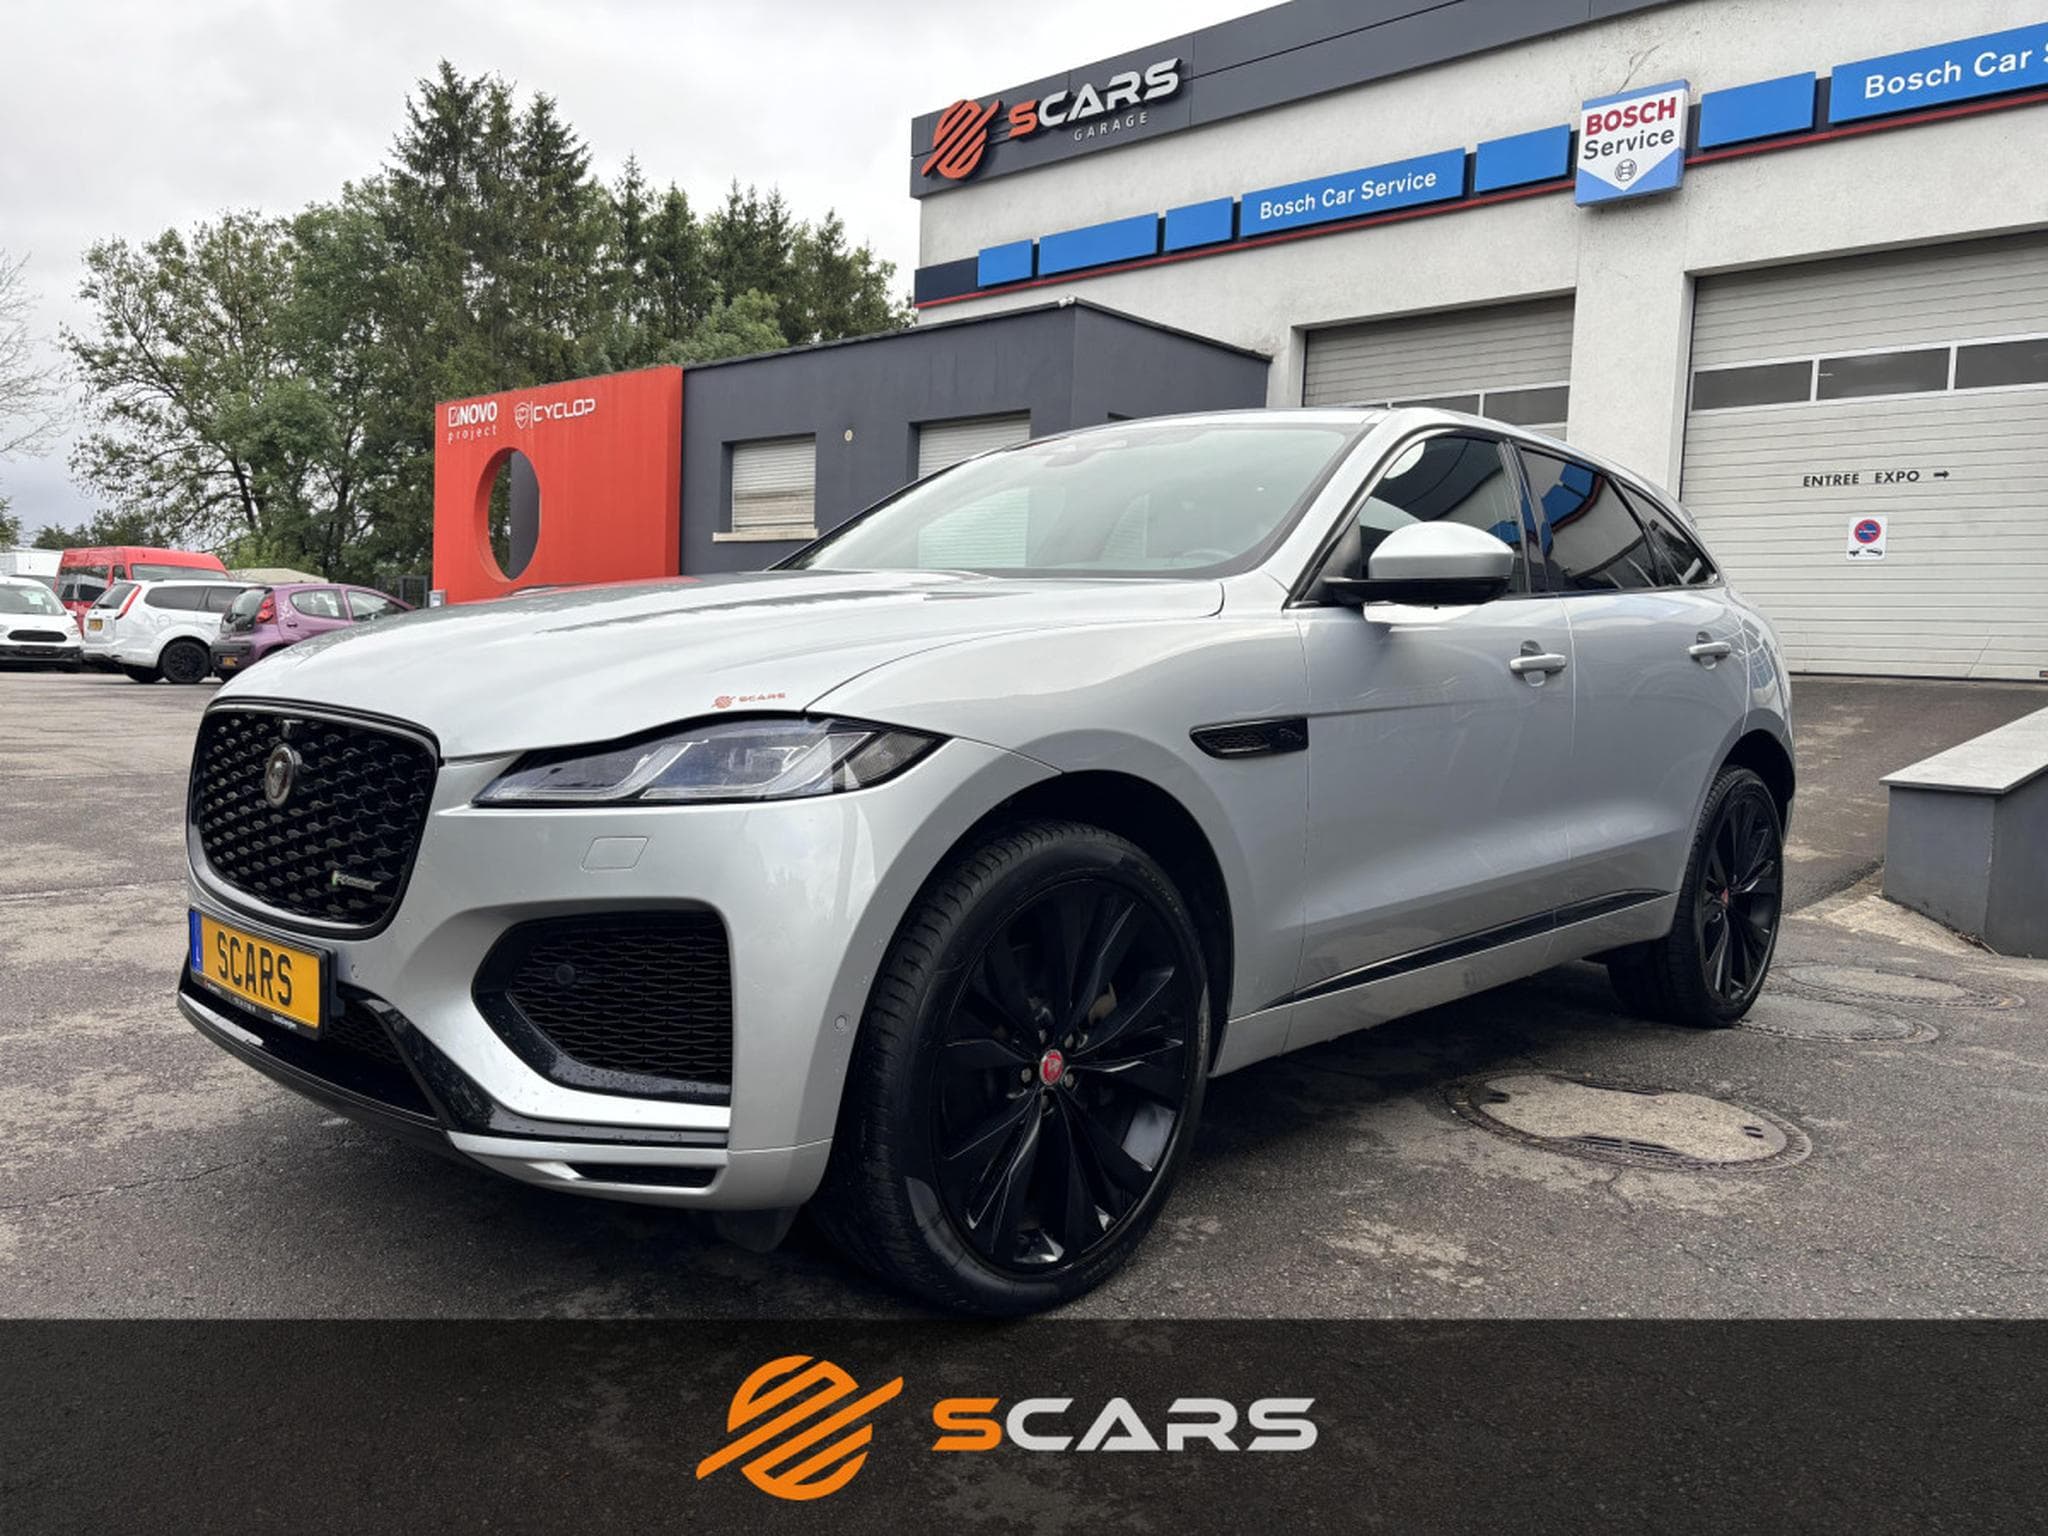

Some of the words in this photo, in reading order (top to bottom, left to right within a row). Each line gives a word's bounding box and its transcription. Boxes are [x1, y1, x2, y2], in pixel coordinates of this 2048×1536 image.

[1864, 60, 1961, 99] Bosch
[1974, 49, 2033, 77] Car
[1008, 57, 1181, 138] SCARS
[1585, 96, 1677, 136] BOSCH
[1073, 111, 1149, 142] GARAGE
[1583, 127, 1675, 161] Service
[1259, 192, 1316, 220] Bosch
[1322, 188, 1355, 208] Car
[1361, 171, 1437, 200] Service
[533, 398, 596, 422] CYCLOP
[448, 423, 497, 445] project
[1802, 473, 1860, 488] ENTREE
[1875, 470, 1920, 484] EXPO
[217, 931, 292, 1006] SCARS
